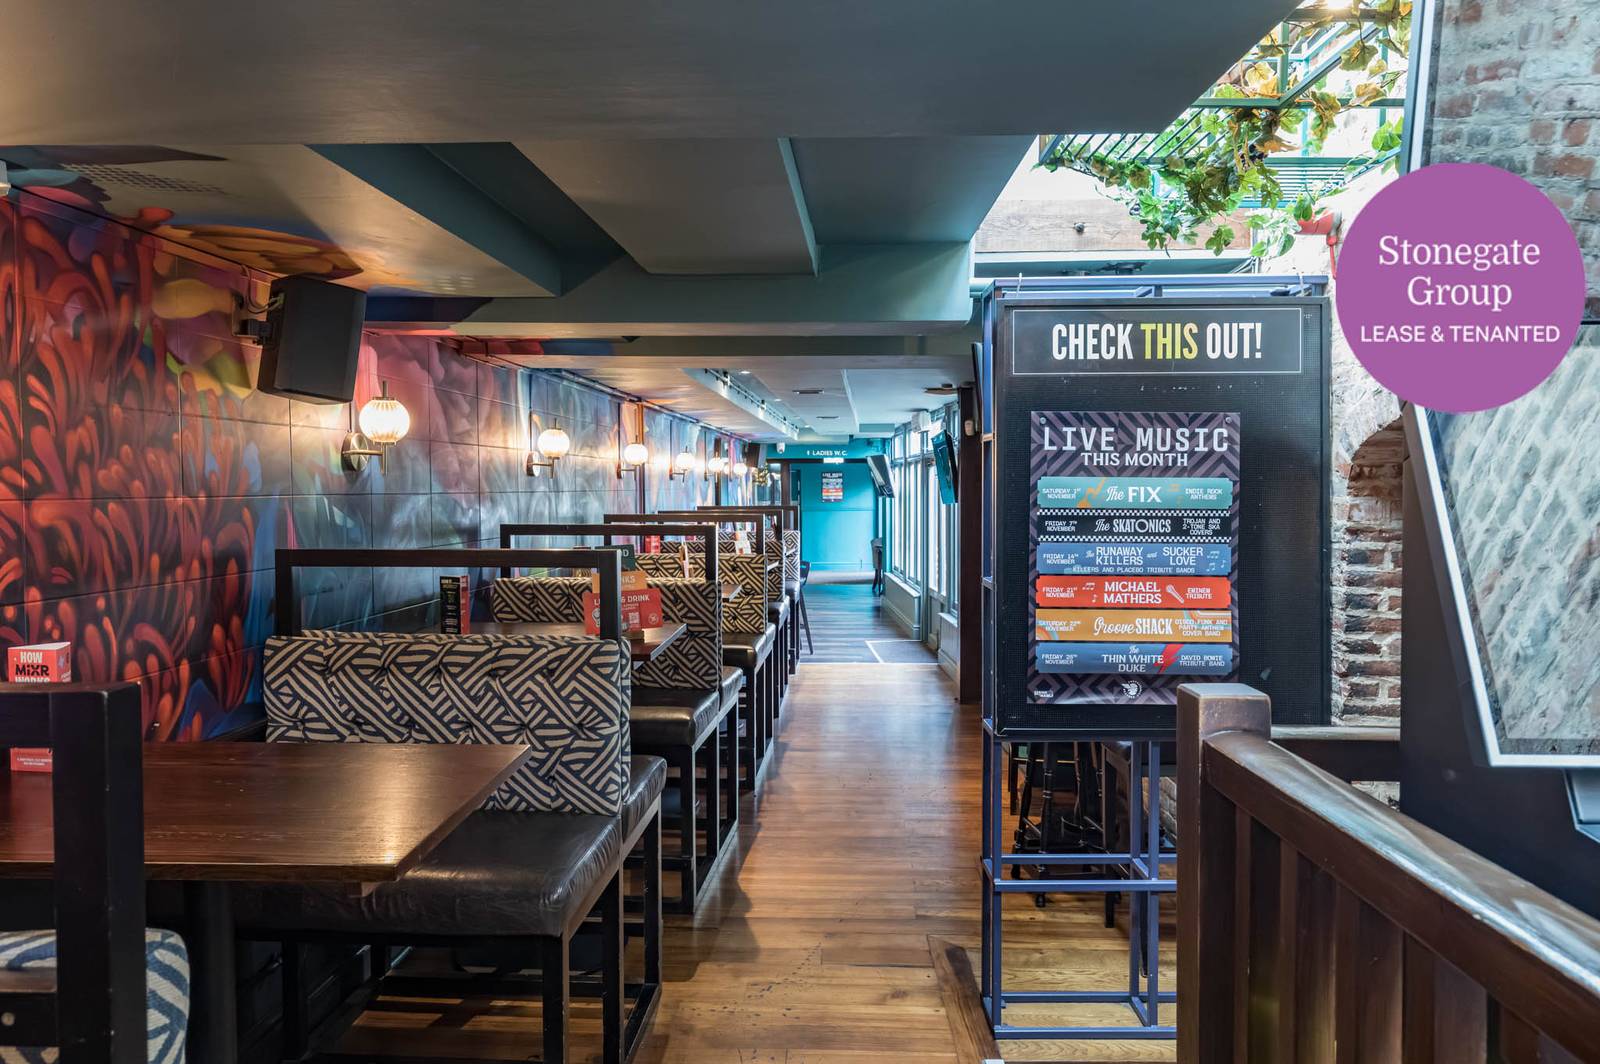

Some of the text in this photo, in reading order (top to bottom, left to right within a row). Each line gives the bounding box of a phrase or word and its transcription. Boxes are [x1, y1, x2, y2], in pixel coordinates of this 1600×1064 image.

[1051, 322, 1262, 360] CHECK THIS OUT!
[1044, 427, 1229, 452] LIVE MUSIC
[1081, 452, 1188, 467] THIS MONTH
[1106, 486, 1162, 503] The FIX
[1094, 519, 1172, 533] The SKATONICS
[1096, 546, 1144, 556] RUNAWAY
[1162, 547, 1204, 557] SUCKER
[1095, 556, 1144, 566] KILLERS
[1169, 556, 1197, 566] LOVE
[1104, 581, 1161, 592] MICHAEL
[627, 594, 650, 603] DRINK
[1103, 593, 1162, 604] MATHERS
[1093, 616, 1173, 636] Groove SHACK
[20, 651, 43, 663] HOW
[1101, 654, 1164, 664] THIN WHITE
[1118, 663, 1146, 672] DUKE
